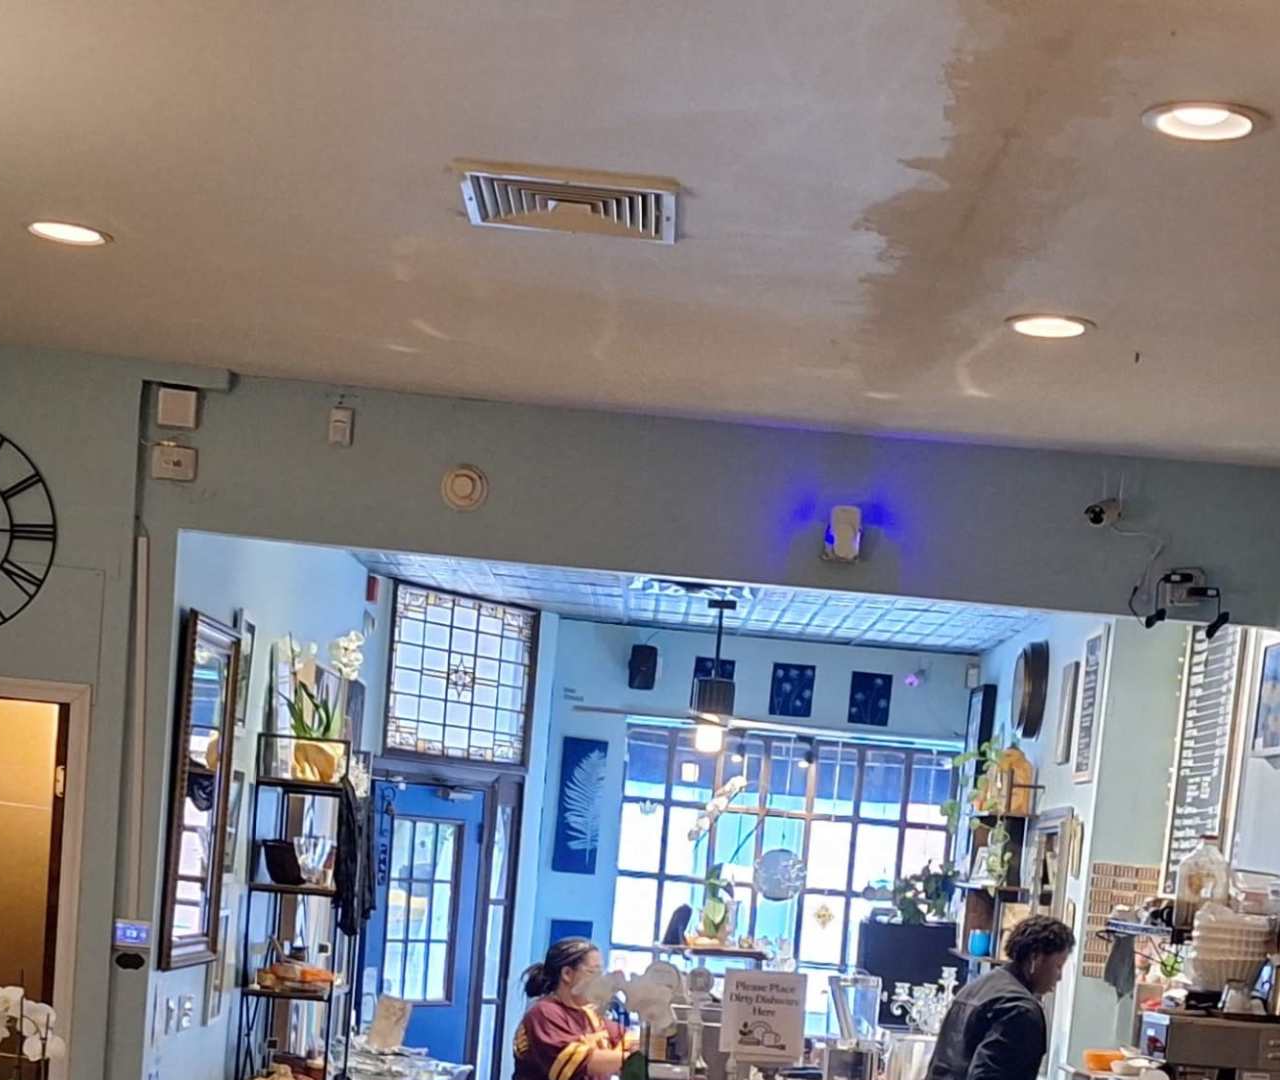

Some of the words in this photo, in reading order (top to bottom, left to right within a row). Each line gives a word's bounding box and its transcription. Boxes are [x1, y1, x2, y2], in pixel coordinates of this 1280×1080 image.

[736, 981, 768, 992] Please
[769, 983, 796, 993] Place
[729, 992, 753, 1005] Dirty
[752, 1005, 776, 1016] Here
